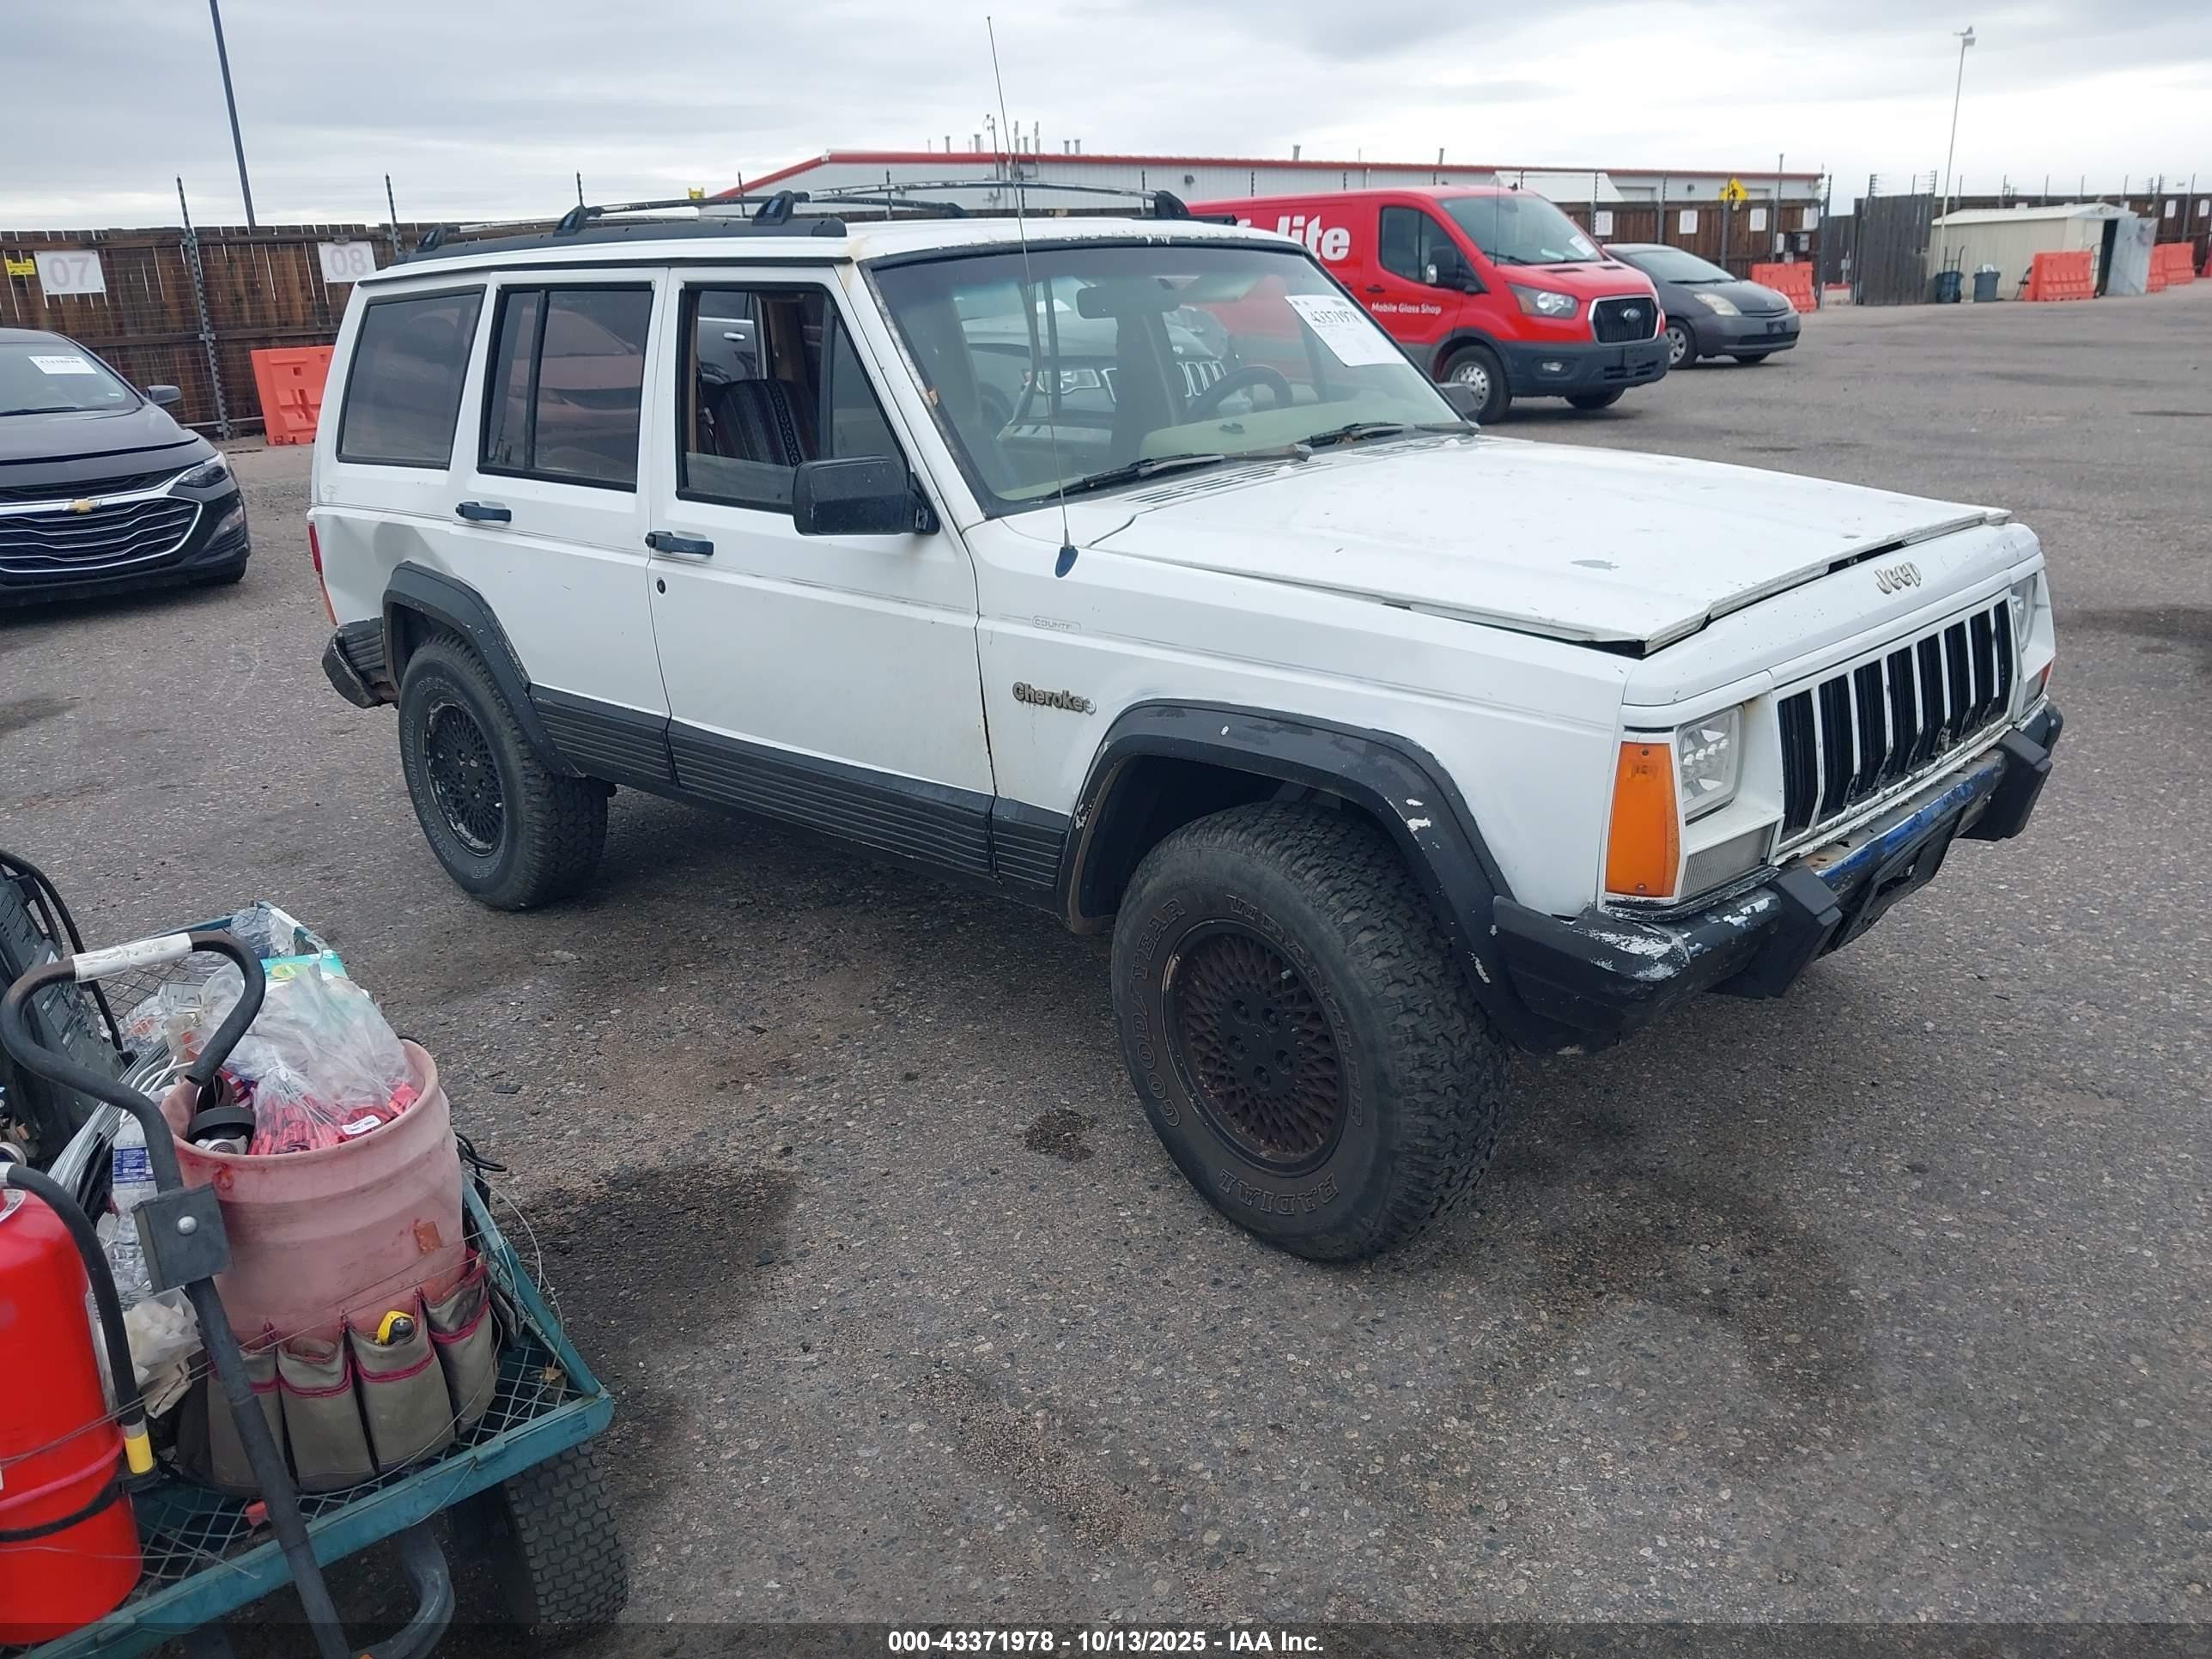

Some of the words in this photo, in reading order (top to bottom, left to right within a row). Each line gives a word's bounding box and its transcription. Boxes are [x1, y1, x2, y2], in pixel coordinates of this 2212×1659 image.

[48, 257, 90, 288] 07
[330, 247, 368, 276] 08
[1371, 302, 1397, 313] Mobile
[1398, 302, 1419, 313] Glass
[1420, 303, 1442, 316] Shop
[1874, 562, 1922, 595] Jeep
[1012, 682, 1097, 715] Cherokee
[1218, 1168, 1340, 1217] RADIAL
